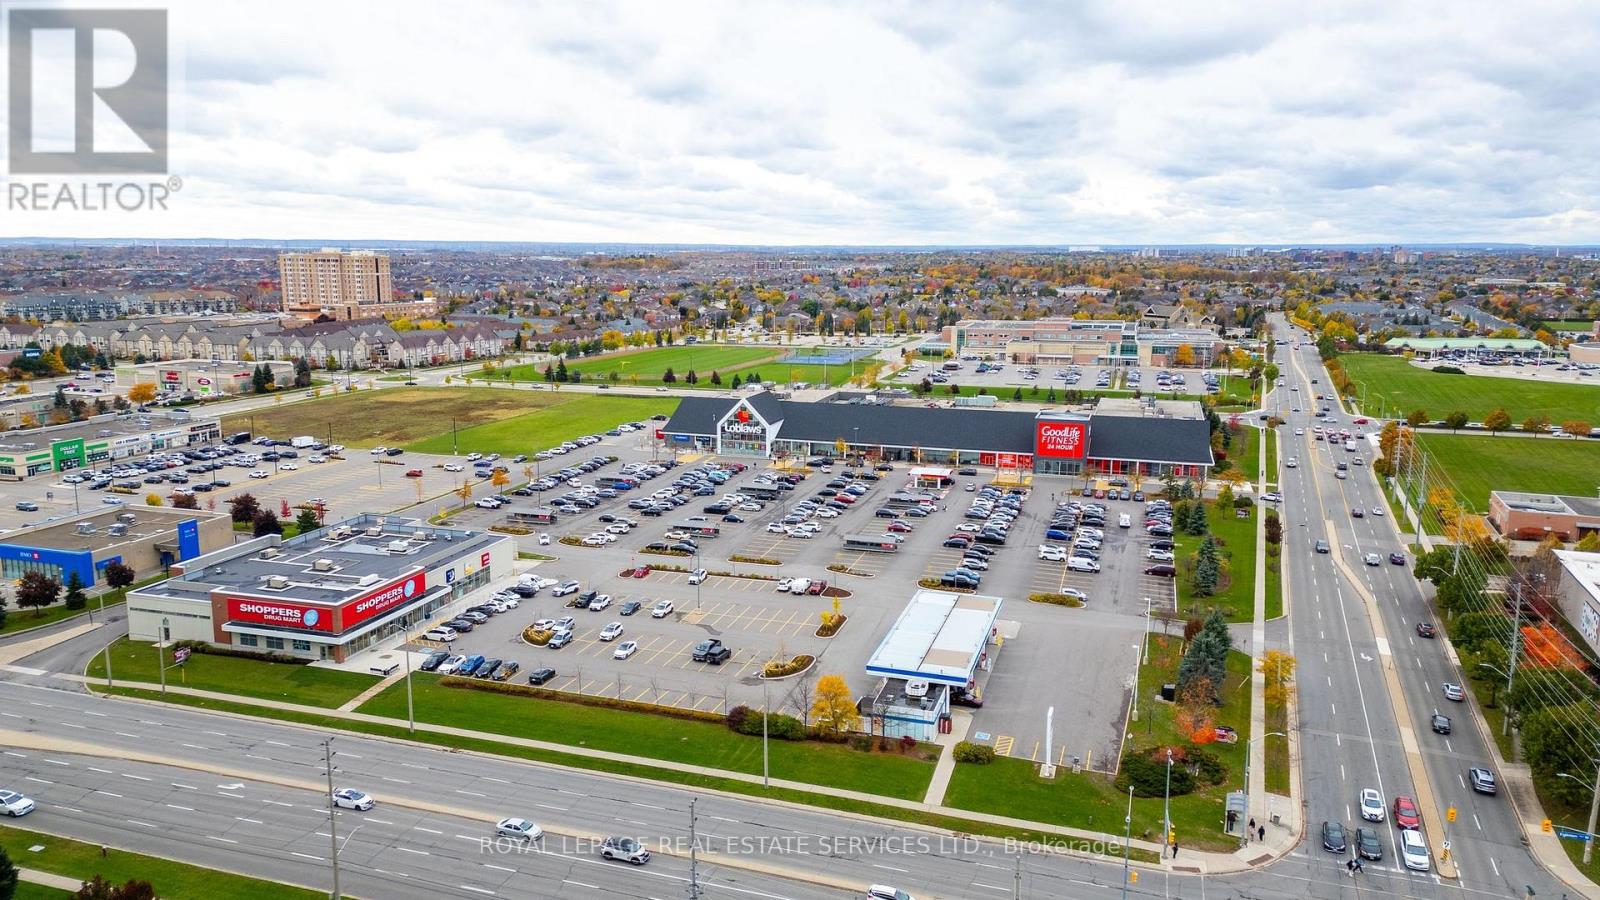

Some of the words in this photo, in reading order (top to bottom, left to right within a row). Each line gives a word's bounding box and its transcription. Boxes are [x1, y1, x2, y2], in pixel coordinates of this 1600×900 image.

[724, 422, 762, 434] Loblaws
[1041, 425, 1080, 438] GoodLife
[1041, 436, 1080, 446] FITNESS
[356, 586, 403, 613] SHOPPERS
[375, 600, 389, 610] DRUG
[239, 603, 302, 618] SHOPPERS
[263, 614, 282, 622] DRUG
[283, 616, 302, 624] MART
